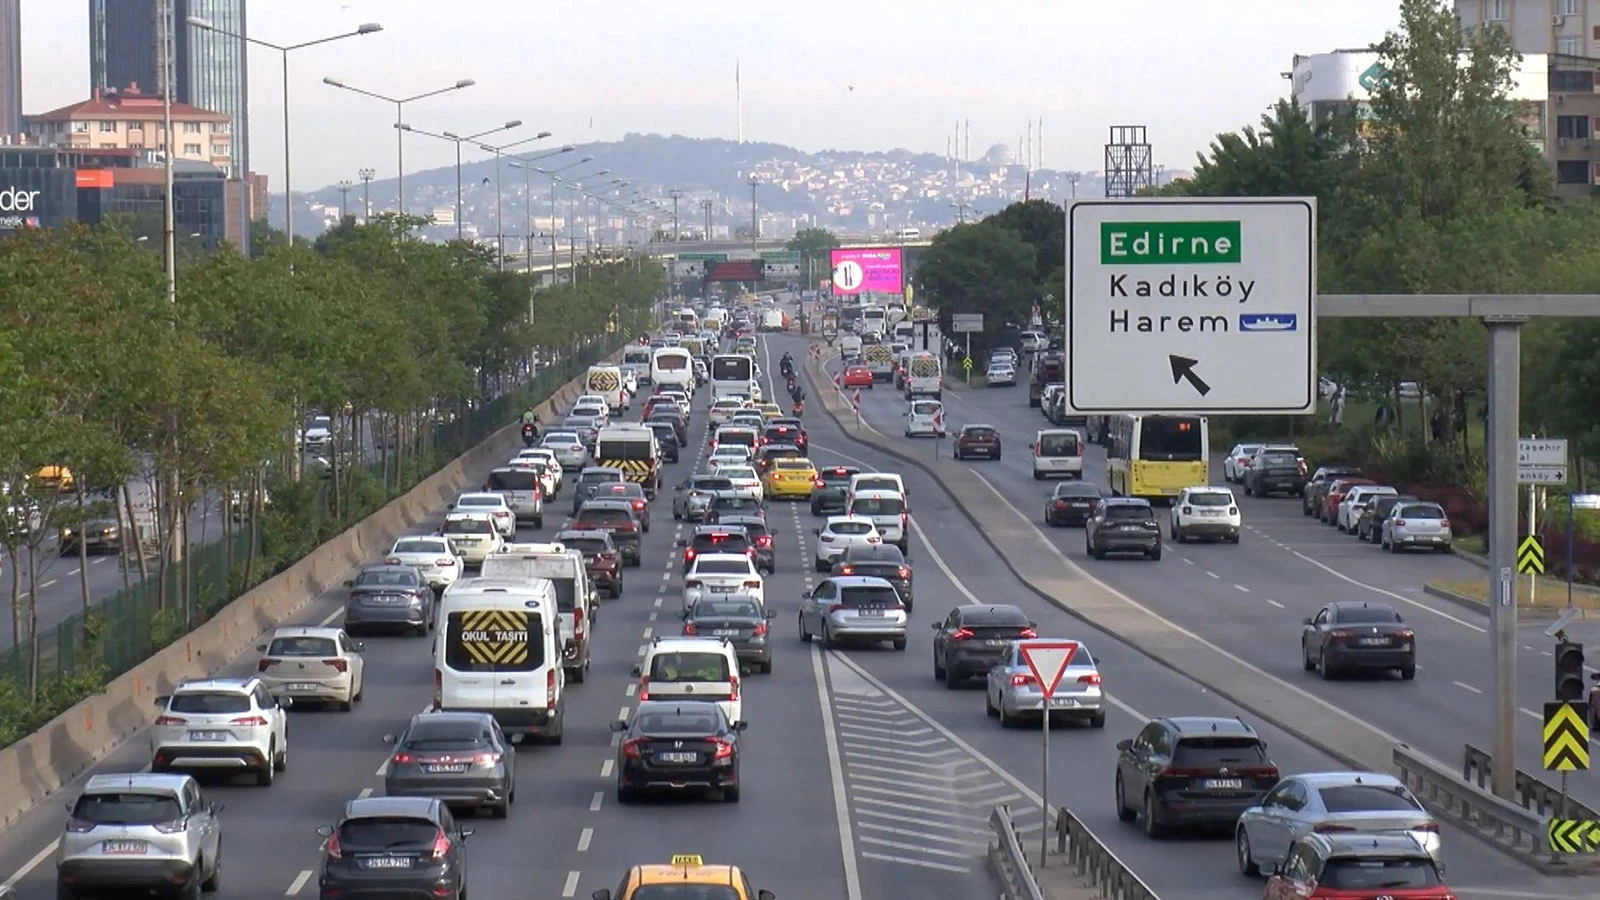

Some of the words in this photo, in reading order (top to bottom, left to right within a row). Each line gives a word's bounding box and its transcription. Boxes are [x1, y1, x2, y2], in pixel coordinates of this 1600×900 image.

[0, 186, 40, 211] der
[1110, 232, 1232, 256] Edirne
[1110, 274, 1255, 303] Kadıköy
[1110, 310, 1228, 332] Harem
[461, 631, 490, 641] OKUL
[495, 631, 528, 643] TAŞITI
